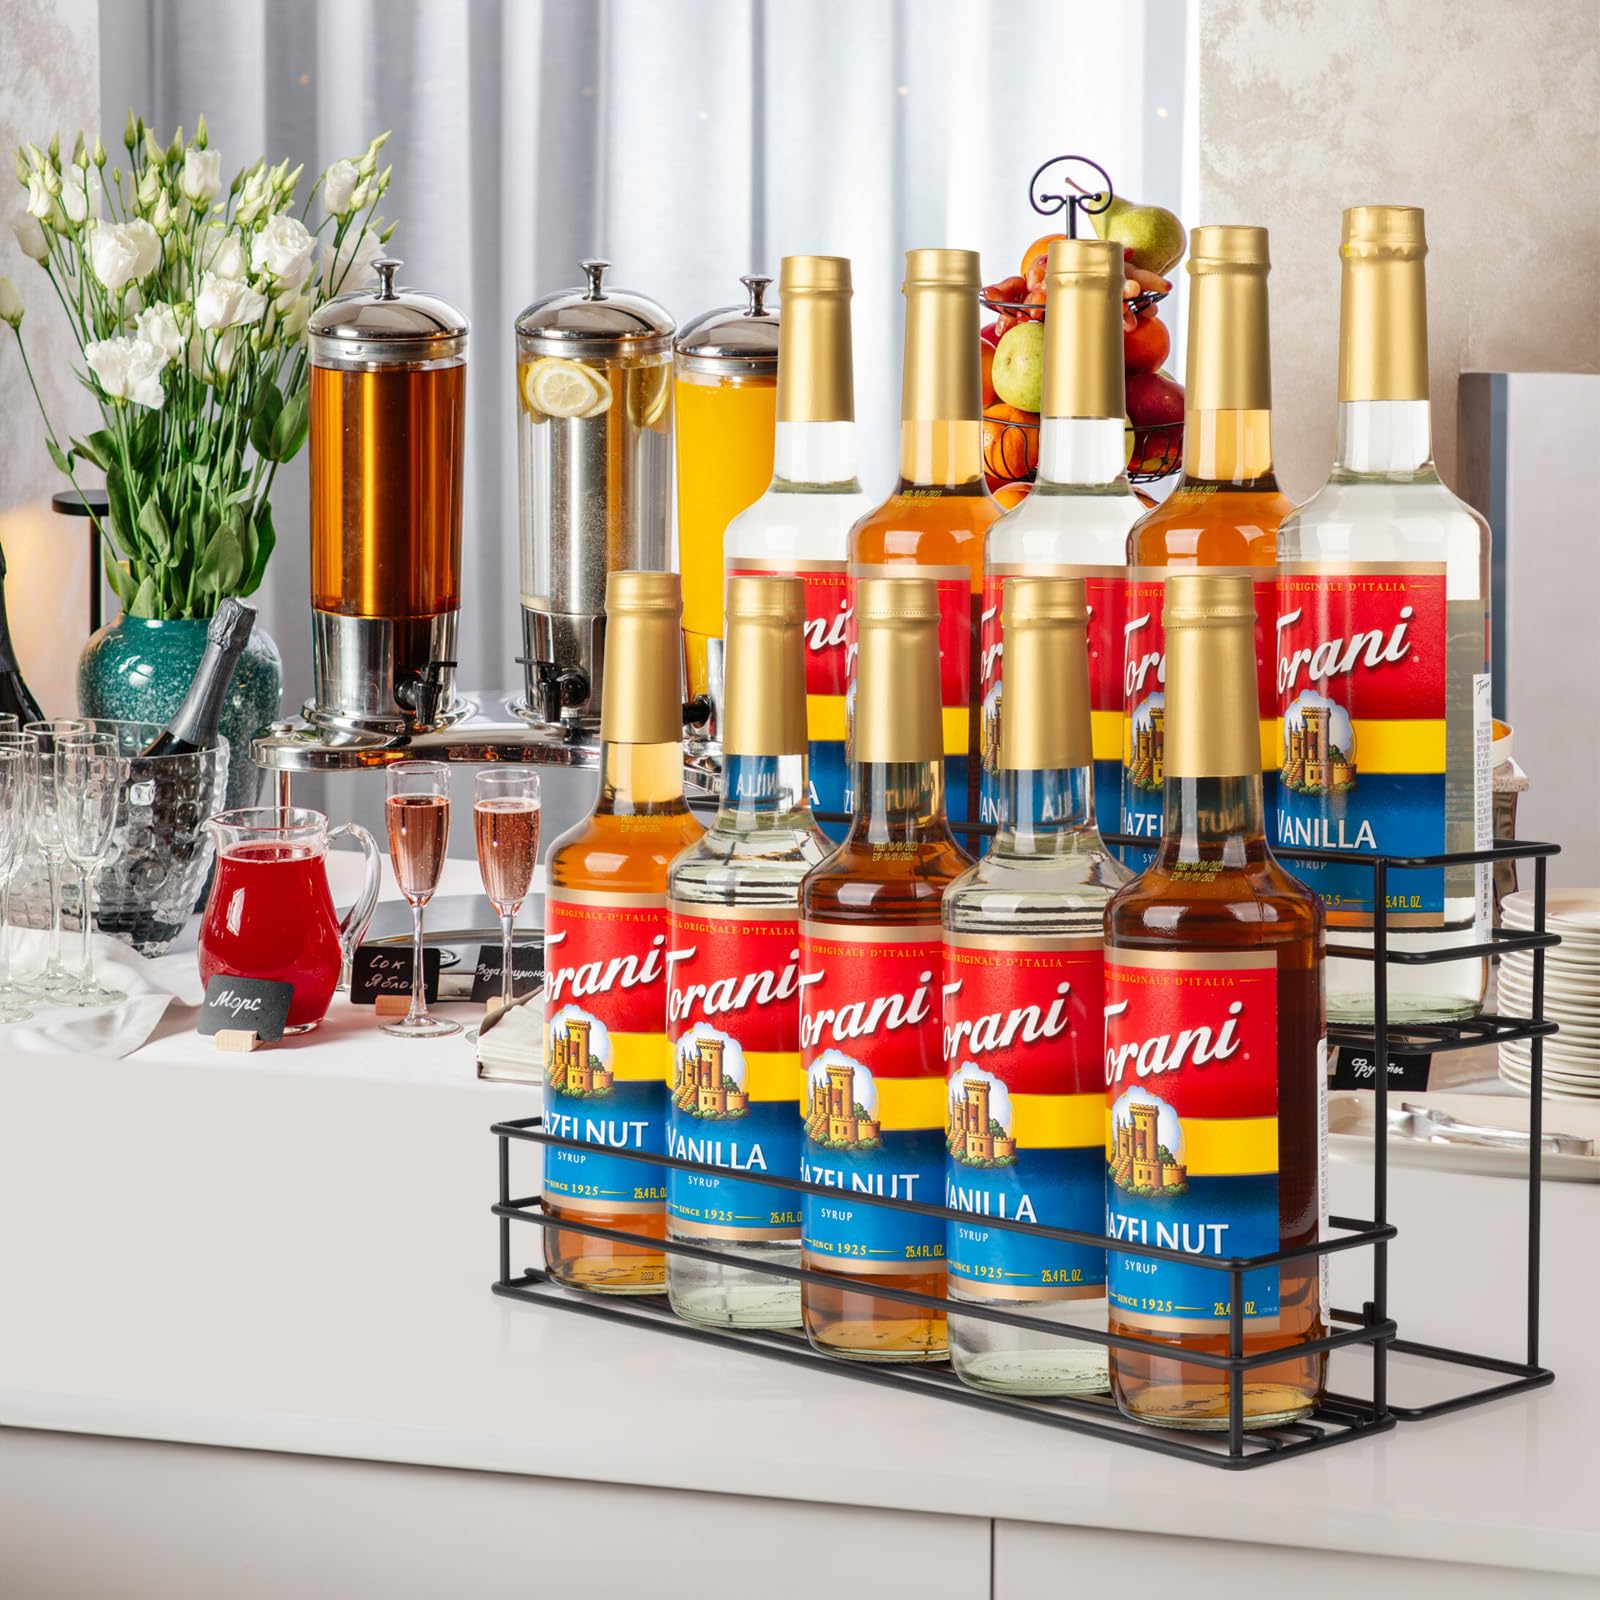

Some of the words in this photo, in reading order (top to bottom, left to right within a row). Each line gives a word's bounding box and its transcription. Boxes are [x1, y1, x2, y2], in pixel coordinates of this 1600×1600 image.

[1349, 582, 1406, 592] D'ITALIA
[1276, 607, 1413, 694] Torani
[1277, 808, 1377, 849] VANILLA
[608, 912, 659, 922] D'ITALIA
[684, 921, 737, 935] ORIGINALE
[742, 926, 795, 935] D'ITALIA
[813, 944, 865, 957] ORIGINALE
[870, 948, 925, 958] D'ITALIA
[1006, 958, 1063, 968] D'ITALIA
[666, 946, 800, 1023] Torani
[1175, 977, 1235, 987] D'ITALIA
[209, 990, 262, 1018] Морс
[799, 969, 932, 1049] Torani
[1104, 999, 1243, 1086] Torani
[1351, 1058, 1404, 1078] Фруты
[542, 1110, 649, 1148] AZELNUT
[667, 1125, 768, 1170] VANILLA
[558, 1151, 586, 1164] SYRUP
[688, 1175, 720, 1188] SYRUP
[571, 1183, 599, 1196] 1925
[634, 1187, 649, 1199] 25.4
[704, 1209, 733, 1222] 1925
[770, 1212, 785, 1224] 25.4
[821, 1207, 853, 1221] SYRUP
[959, 1228, 989, 1242] SYRUP
[837, 1242, 867, 1256] 1925
[905, 1245, 921, 1258] 25.4
[973, 1265, 1003, 1279] 1925
[1125, 1259, 1158, 1274] SYRUP
[1041, 1269, 1058, 1283] 25.4
[1117, 1293, 1138, 1307] SINCE
[1141, 1297, 1172, 1312] 1925
[1245, 1301, 1257, 1315] OZ.
